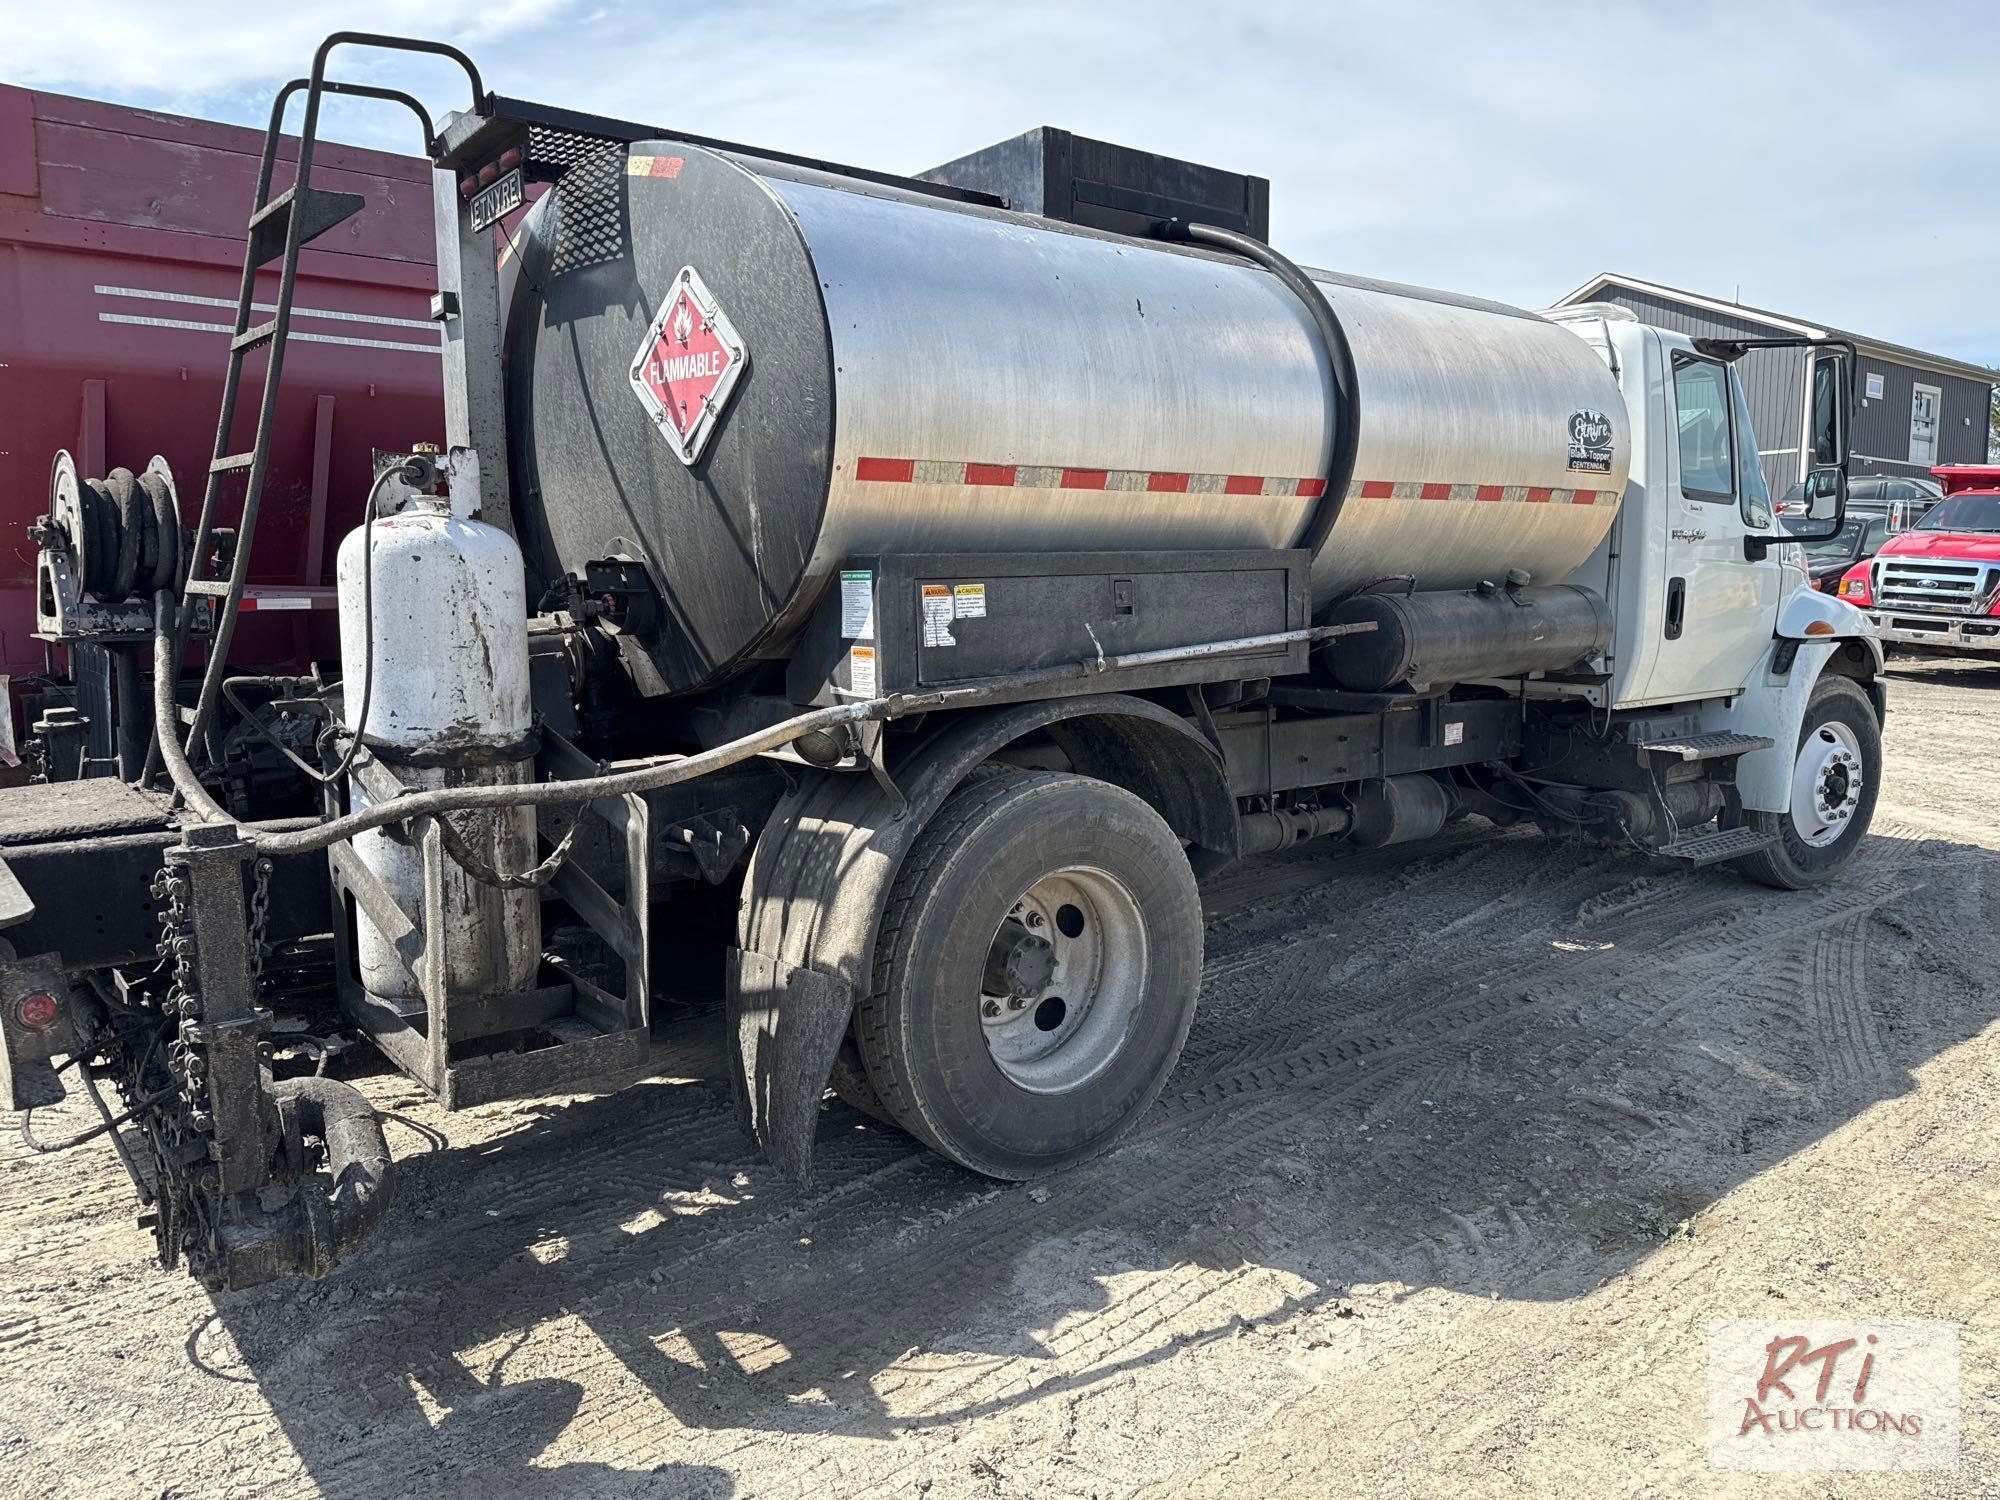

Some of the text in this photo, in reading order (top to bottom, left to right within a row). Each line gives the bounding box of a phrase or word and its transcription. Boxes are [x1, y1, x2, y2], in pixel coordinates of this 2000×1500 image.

[473, 176, 517, 226] ETNYRE
[1575, 417, 1608, 442] Etnyre
[1571, 460, 1606, 470] CENTENNIAL
